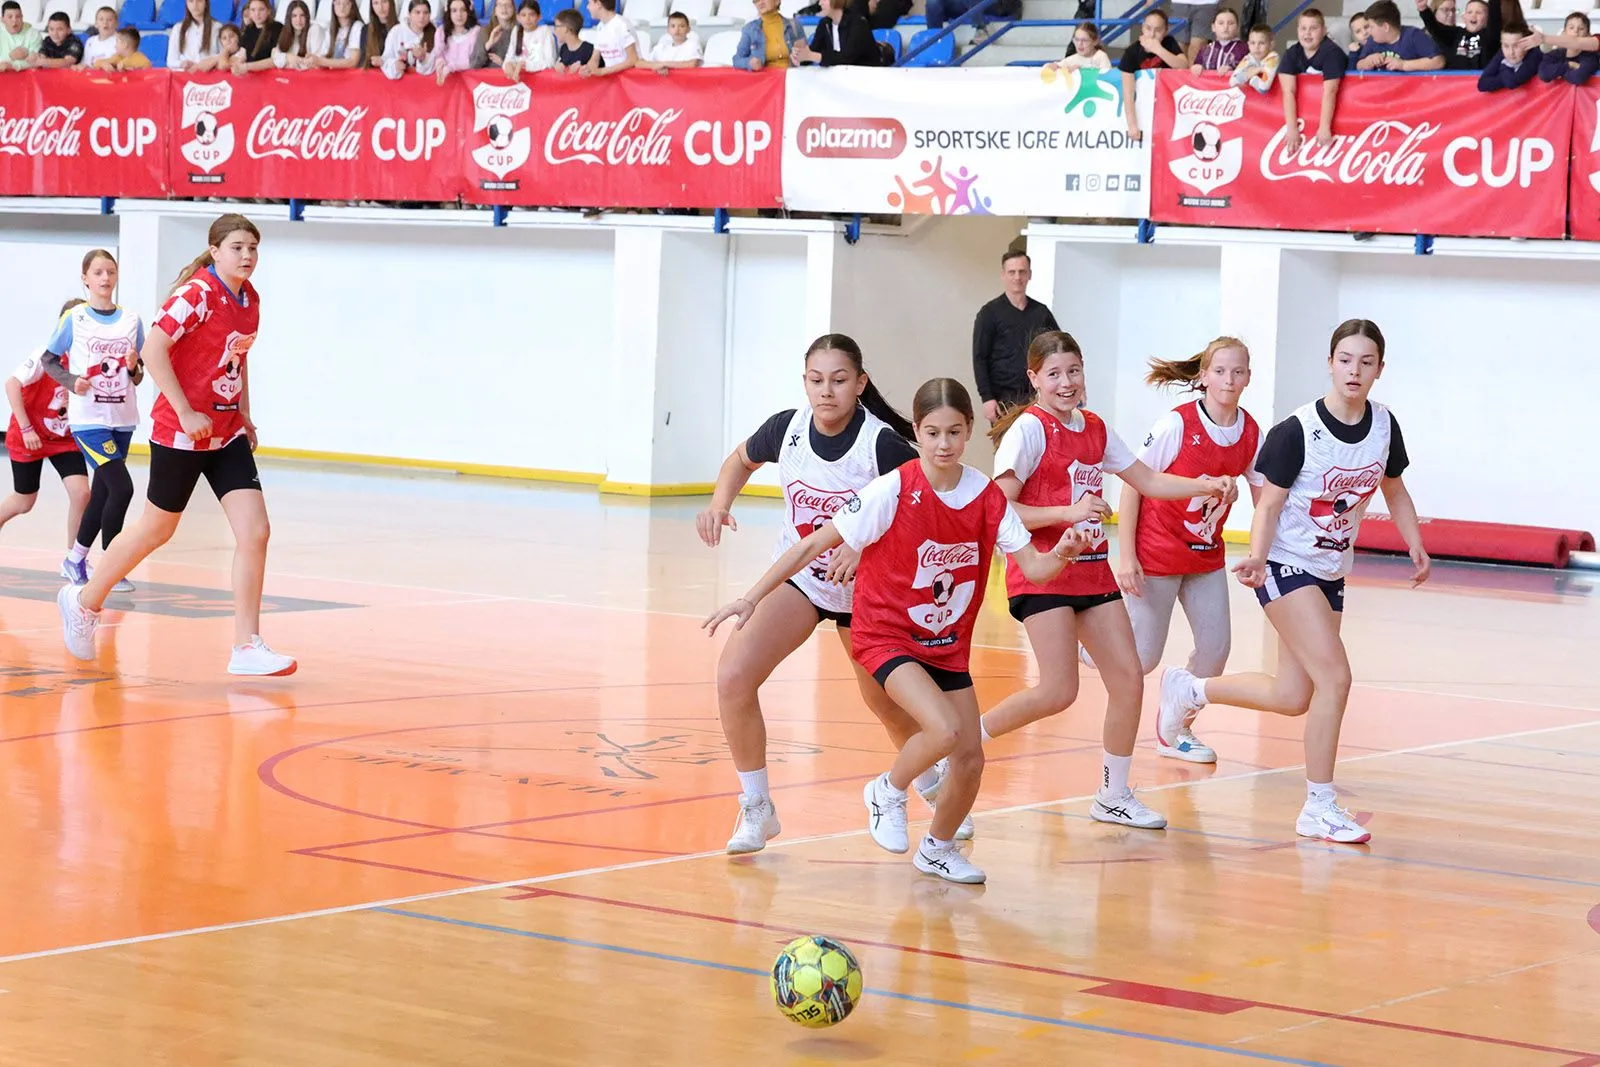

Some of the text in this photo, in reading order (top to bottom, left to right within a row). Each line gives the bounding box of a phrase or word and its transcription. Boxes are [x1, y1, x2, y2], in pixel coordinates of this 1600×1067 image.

[89, 117, 157, 157] CUP
[371, 118, 446, 161] CUP
[684, 120, 772, 166] CUP
[805, 121, 896, 154] plazma
[914, 130, 1011, 150] SPORTSKE
[1018, 130, 1060, 150] IGRE
[193, 150, 220, 160] CUP
[487, 155, 513, 166] CUP
[1442, 136, 1555, 189] CUP
[1188, 167, 1224, 180] CUP
[99, 380, 121, 389] CUP
